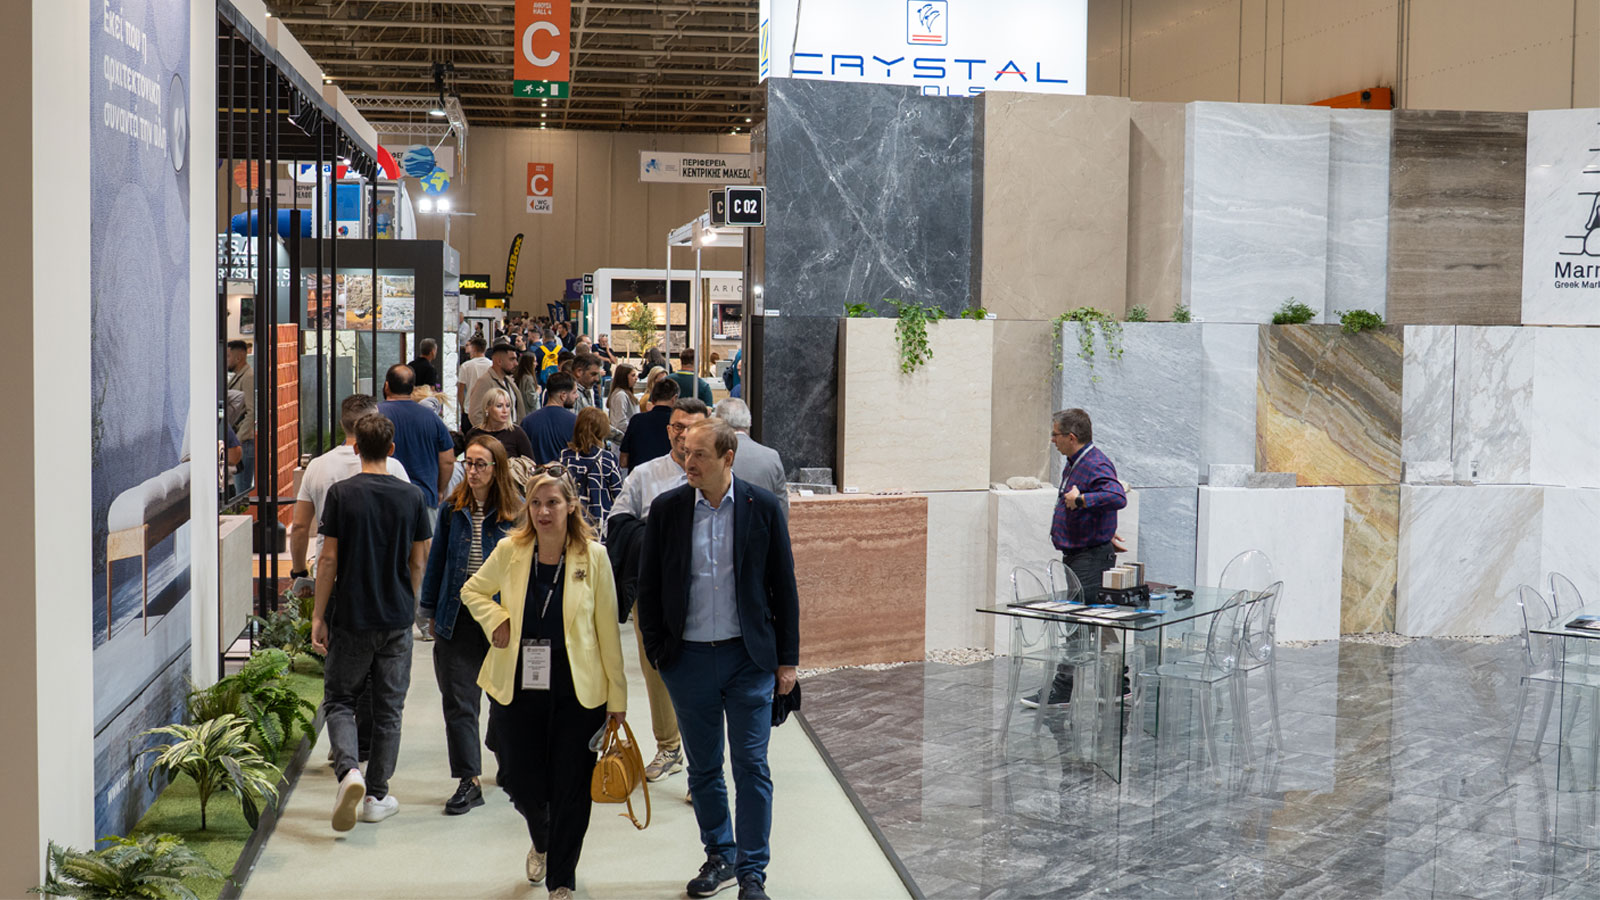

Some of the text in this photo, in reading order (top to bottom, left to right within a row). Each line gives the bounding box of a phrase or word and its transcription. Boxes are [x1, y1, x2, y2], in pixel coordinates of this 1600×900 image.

[141, 31, 147, 64] η
[522, 21, 561, 67] C
[790, 52, 1069, 84] CRYSTAL
[922, 85, 986, 97] OLS
[682, 158, 727, 168] ΠΕΡΙΦΕΡΕΙΑ
[682, 167, 721, 179] ΚΕΝΤΡΙΚΗΣ
[530, 174, 549, 195] C
[534, 204, 551, 212] CAFE
[717, 201, 724, 215] C
[734, 199, 757, 214] C 02
[506, 237, 523, 295] Go4Box
[1554, 280, 1580, 289] Greek
